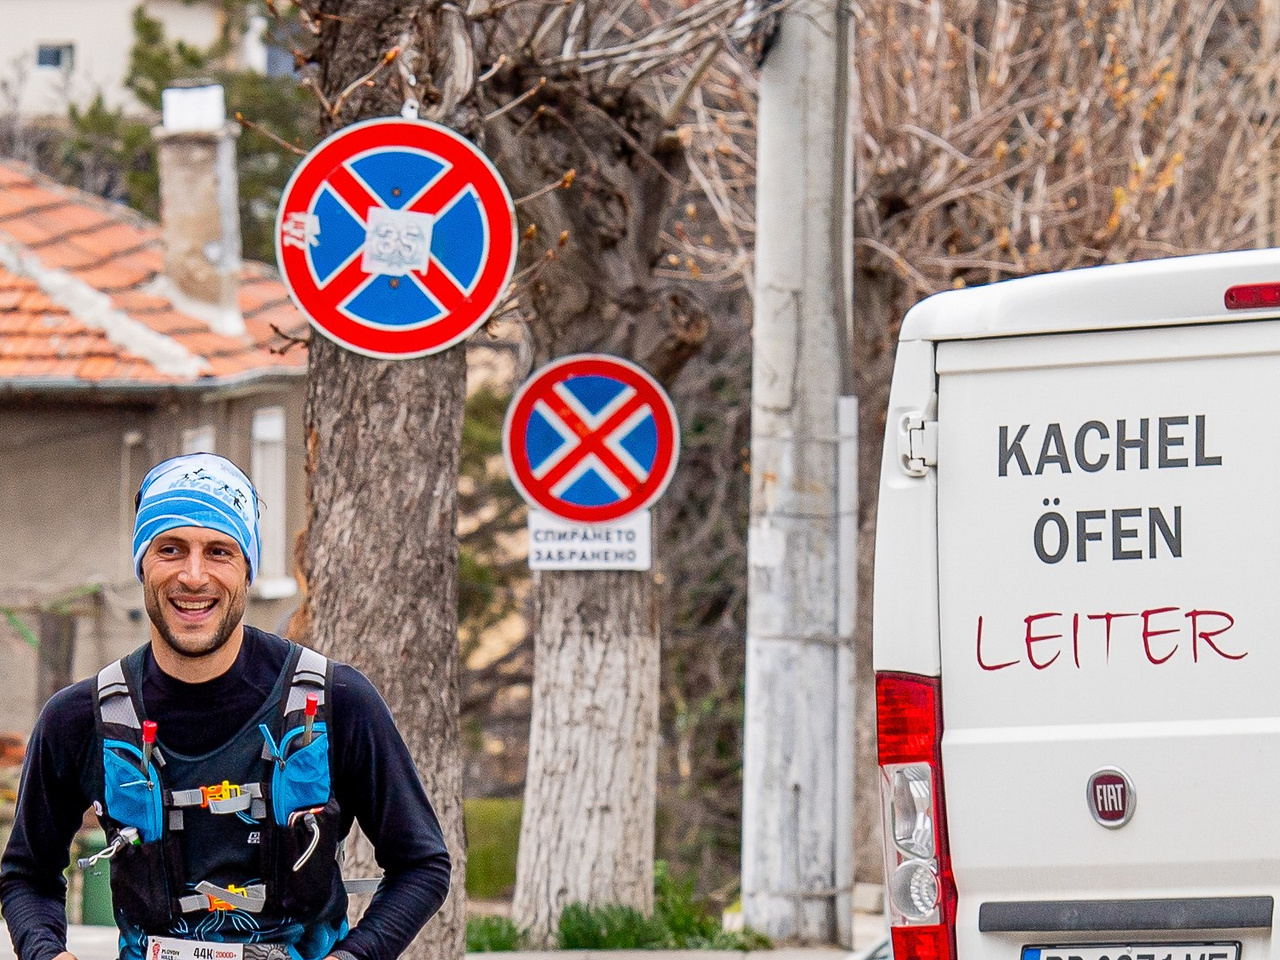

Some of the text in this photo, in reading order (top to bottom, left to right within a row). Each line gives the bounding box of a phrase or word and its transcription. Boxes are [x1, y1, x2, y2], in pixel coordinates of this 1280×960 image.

[998, 415, 1222, 477] KACHEL
[533, 529, 637, 543] СПИРАНЕТО
[1033, 498, 1183, 564] ÖFEN
[534, 550, 637, 562] ЗАБРАНЕНО
[977, 606, 1248, 671] LEITER
[1096, 784, 1124, 811] FIAT
[193, 947, 213, 960] 44K
